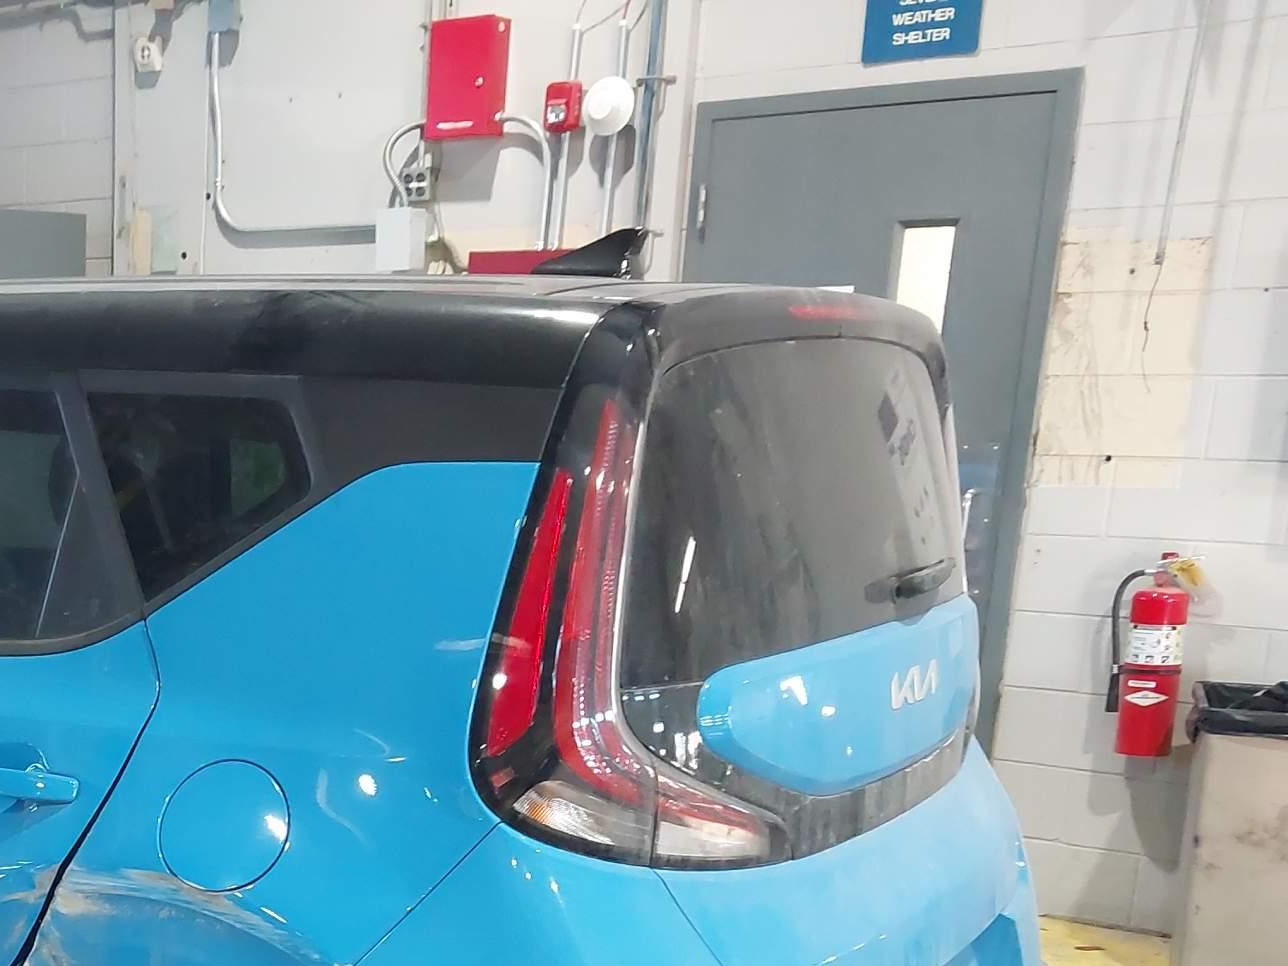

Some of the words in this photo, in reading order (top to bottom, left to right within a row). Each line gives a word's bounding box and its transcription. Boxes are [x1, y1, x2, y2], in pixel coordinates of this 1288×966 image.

[892, 7, 955, 26] WEATHER
[892, 27, 951, 45] SHELTER
[891, 659, 936, 709] KIA
